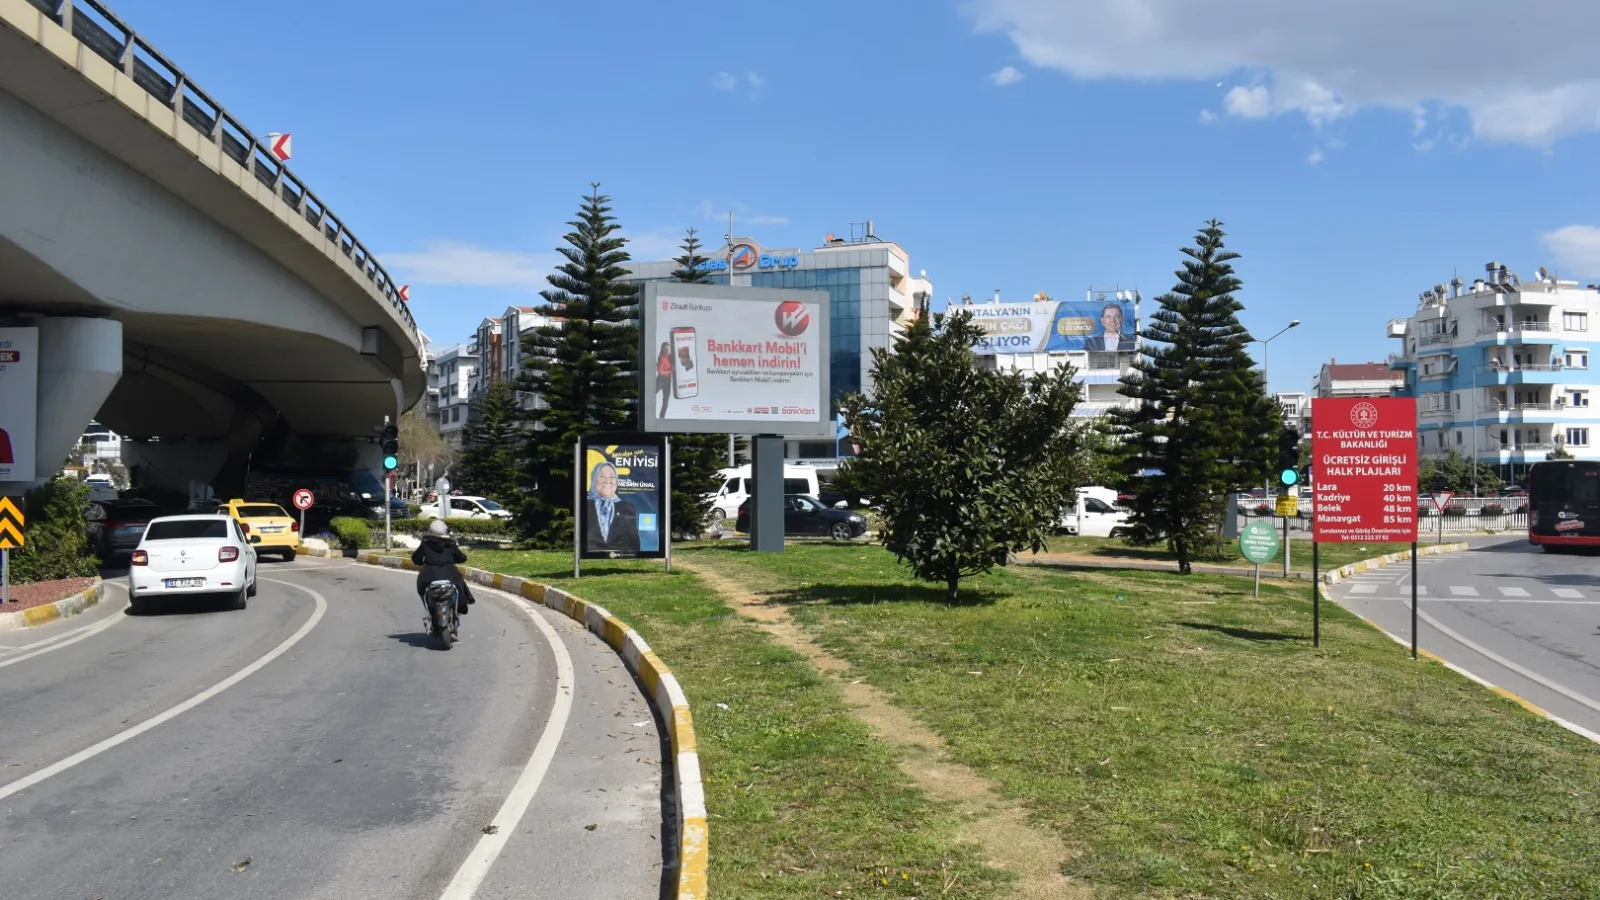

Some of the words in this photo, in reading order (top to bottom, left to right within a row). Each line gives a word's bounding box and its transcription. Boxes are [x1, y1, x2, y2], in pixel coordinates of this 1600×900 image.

[758, 253, 799, 268] Grup
[670, 302, 688, 310] Ziraat
[688, 303, 713, 311] Bankası
[707, 339, 763, 353] Bankkart
[765, 341, 807, 355] Mobil'i
[713, 353, 755, 367] hemen
[758, 355, 801, 369] indirin!
[706, 367, 731, 375] Bankkart
[781, 407, 815, 415] bankkart
[1316, 431, 1331, 439] T.C.
[1332, 430, 1366, 438] KÜLTÜR
[1379, 430, 1413, 438] TURİZM
[1340, 439, 1387, 448] BAKANLIĞI
[615, 457, 631, 466] EN
[633, 455, 658, 468] İYİSİ
[1323, 454, 1370, 464] ÜCRETSİZ
[1371, 454, 1406, 466] GİRİŞLİ
[1326, 467, 1353, 476] HALK
[1355, 467, 1401, 476] PLAJLARI
[1317, 483, 1337, 491] Lara
[1383, 484, 1395, 492] 20
[1396, 484, 1411, 492] km
[1317, 493, 1351, 503] Kadriye
[1383, 494, 1395, 502] 40
[1396, 494, 1411, 502] km
[1317, 504, 1342, 512] Belek
[1383, 504, 1395, 513] 48
[1396, 504, 1411, 513] km
[1317, 514, 1361, 524] Manavgat
[1383, 515, 1395, 523] 85
[1396, 515, 1411, 523] km
